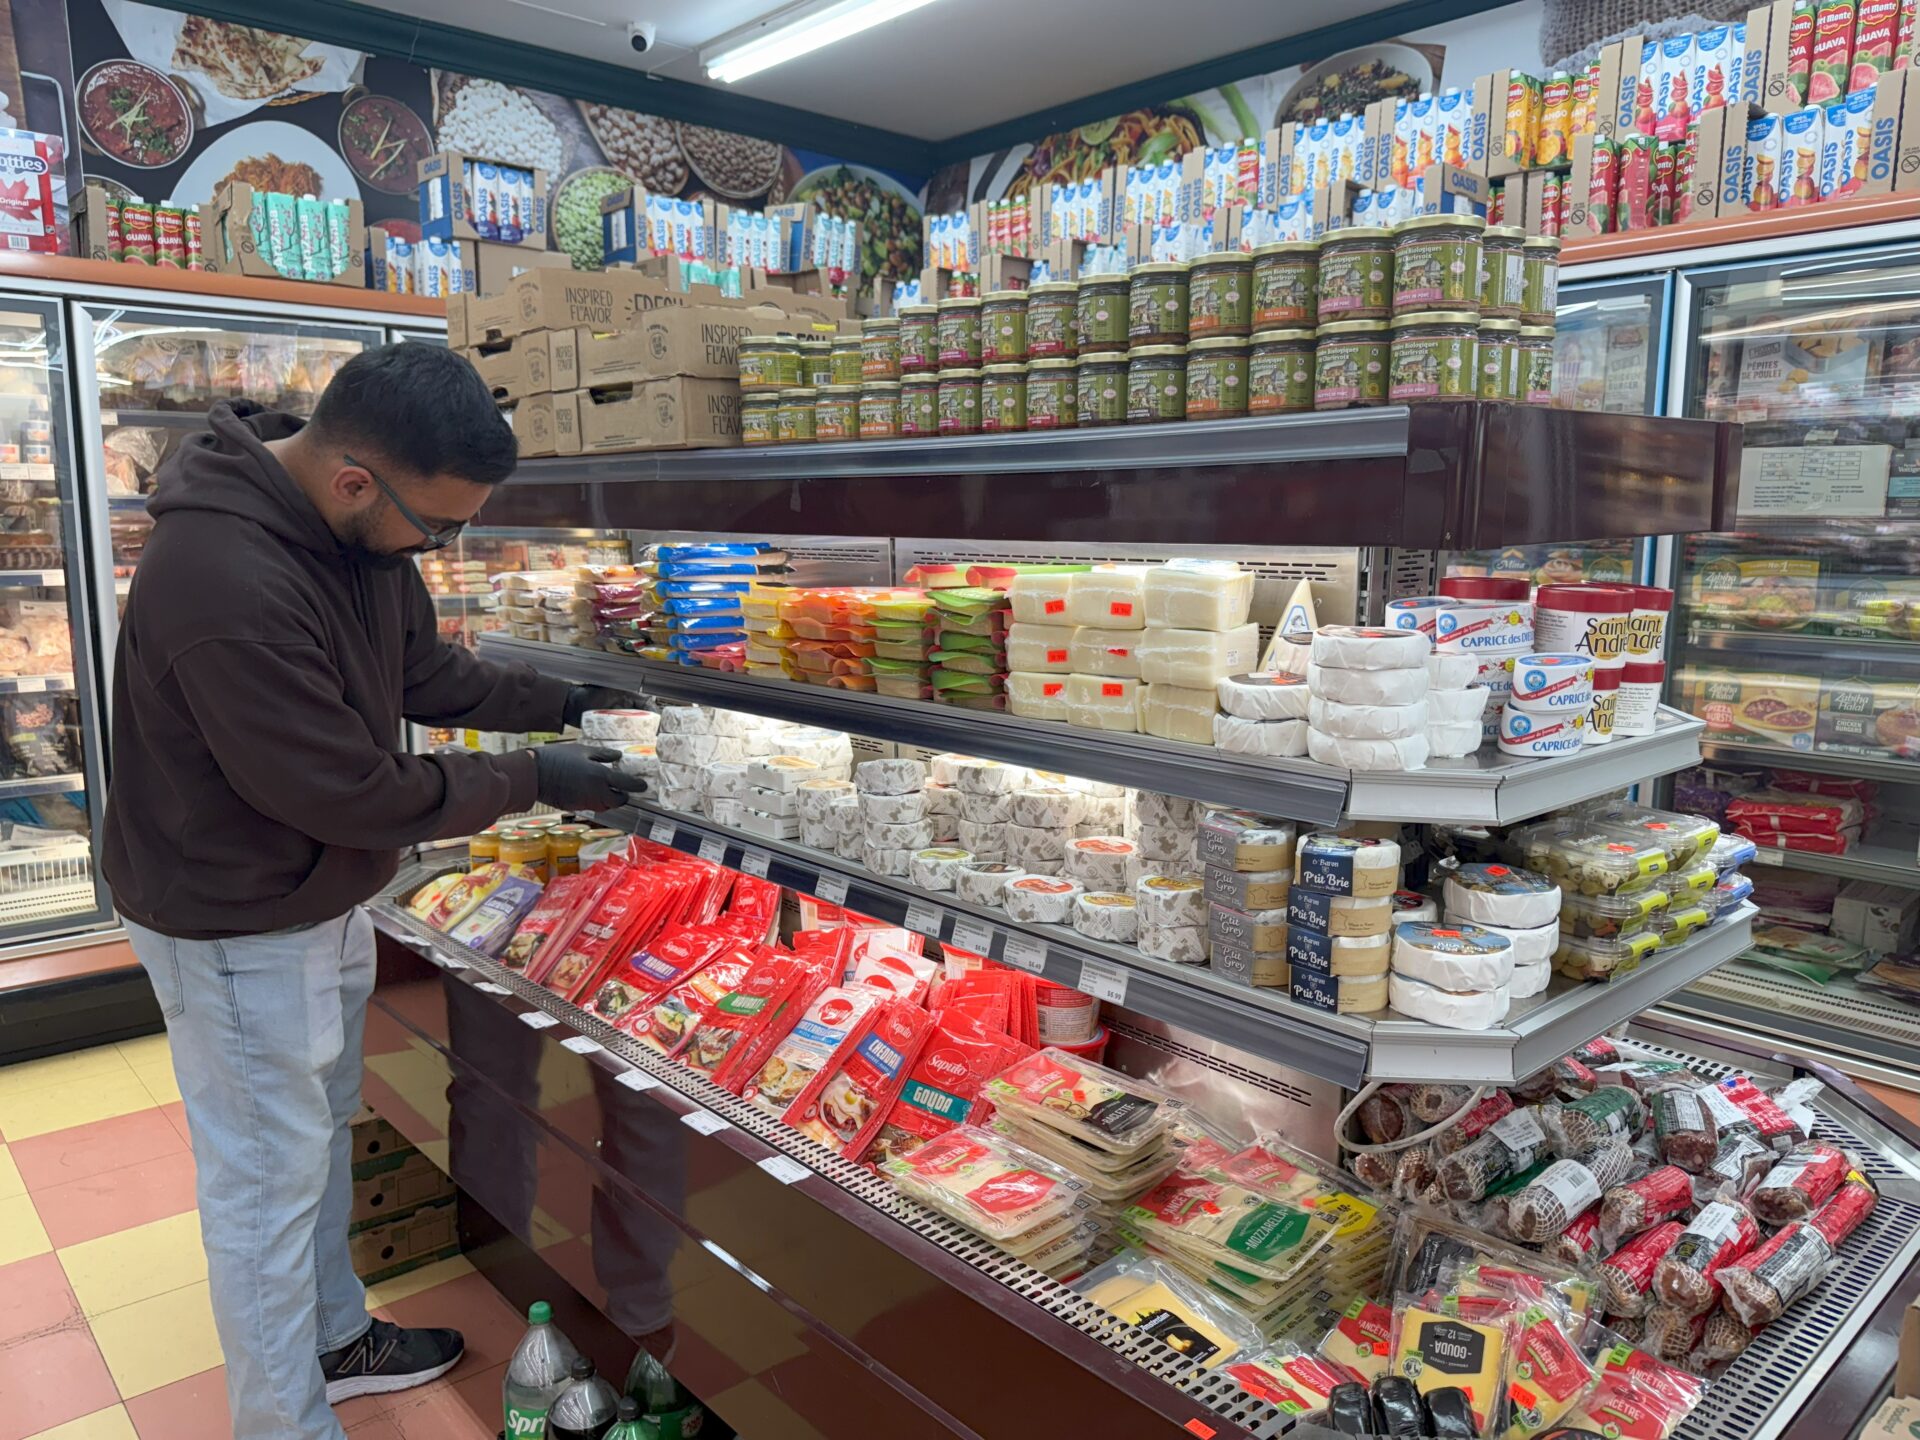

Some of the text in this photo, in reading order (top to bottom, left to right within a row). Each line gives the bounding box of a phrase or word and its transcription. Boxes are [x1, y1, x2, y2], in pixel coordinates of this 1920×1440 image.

[1827, 11, 1851, 22] Monte
[1871, 2, 1897, 13] Monte
[1814, 36, 1846, 54] GUAVA
[1856, 28, 1890, 45] GUAVA
[1657, 71, 1671, 121] OASIS
[1690, 64, 1706, 115] OASIS
[1619, 75, 1637, 128] OASIS
[1472, 112, 1488, 161] OASIS
[1379, 133, 1391, 178] OASIS
[1841, 129, 1854, 187] OASIS
[1871, 117, 1895, 180] OASIS
[1363, 137, 1375, 181] OASIS
[1279, 154, 1291, 197] OASIS
[1723, 145, 1743, 204] OASIS
[1778, 149, 1795, 203] OASIS
[1820, 142, 1838, 197] OASIS
[1265, 162, 1276, 204] OASIS
[1453, 172, 1479, 194] OASIS
[0, 197, 29, 207] Original
[453, 182, 464, 221] OASIS
[478, 187, 488, 222] OASIS
[1181, 183, 1191, 223] OASIS
[1193, 178, 1203, 218] OASIS
[500, 192, 510, 225] OASIS
[522, 196, 532, 229] OASIS
[536, 197, 545, 233] OASIS
[1101, 198, 1111, 235] OASIS
[565, 287, 613, 307] INSPIRED
[571, 306, 613, 324] FLAVOR
[1747, 360, 1779, 370] PÉPITES
[1753, 368, 1782, 379] POULET
[1461, 634, 1521, 648] CAPRICE des
[1708, 683, 1738, 695] Zabiha
[1711, 692, 1734, 701] Halal
[1834, 691, 1870, 704] Zabiha
[1548, 694, 1586, 706] CAPRICE
[1707, 704, 1731, 714] PIZZA
[1837, 700, 1864, 712] Halal
[1836, 719, 1863, 728] CHICKEN
[1532, 740, 1572, 752] CAPRICE
[1205, 830, 1224, 844] P'tit
[1208, 840, 1227, 855] Grey
[1319, 859, 1339, 868] Baron
[1213, 869, 1233, 884] P'tit
[1304, 871, 1350, 888] P'tit Brie
[1216, 880, 1237, 895] Grey
[1303, 895, 1320, 906] Baron
[1218, 911, 1240, 926] P'tit
[1289, 905, 1327, 927] P'tit Brie
[1221, 922, 1244, 937] Grey
[1303, 936, 1320, 947] Baron
[1222, 945, 1242, 960] P'tit
[1289, 946, 1329, 968] P'tit Brie
[1224, 957, 1245, 971] Grey
[1307, 974, 1326, 985] Baron
[1293, 984, 1335, 1006] P'tit Brie
[891, 1017, 913, 1040] Saputo
[867, 1038, 901, 1071] CHEDDAR
[927, 1054, 968, 1078] Saputo
[912, 1085, 953, 1113] GOUDA
[1250, 1210, 1288, 1250] MOZZARELLA
[1434, 1340, 1468, 1359] GOUDA
